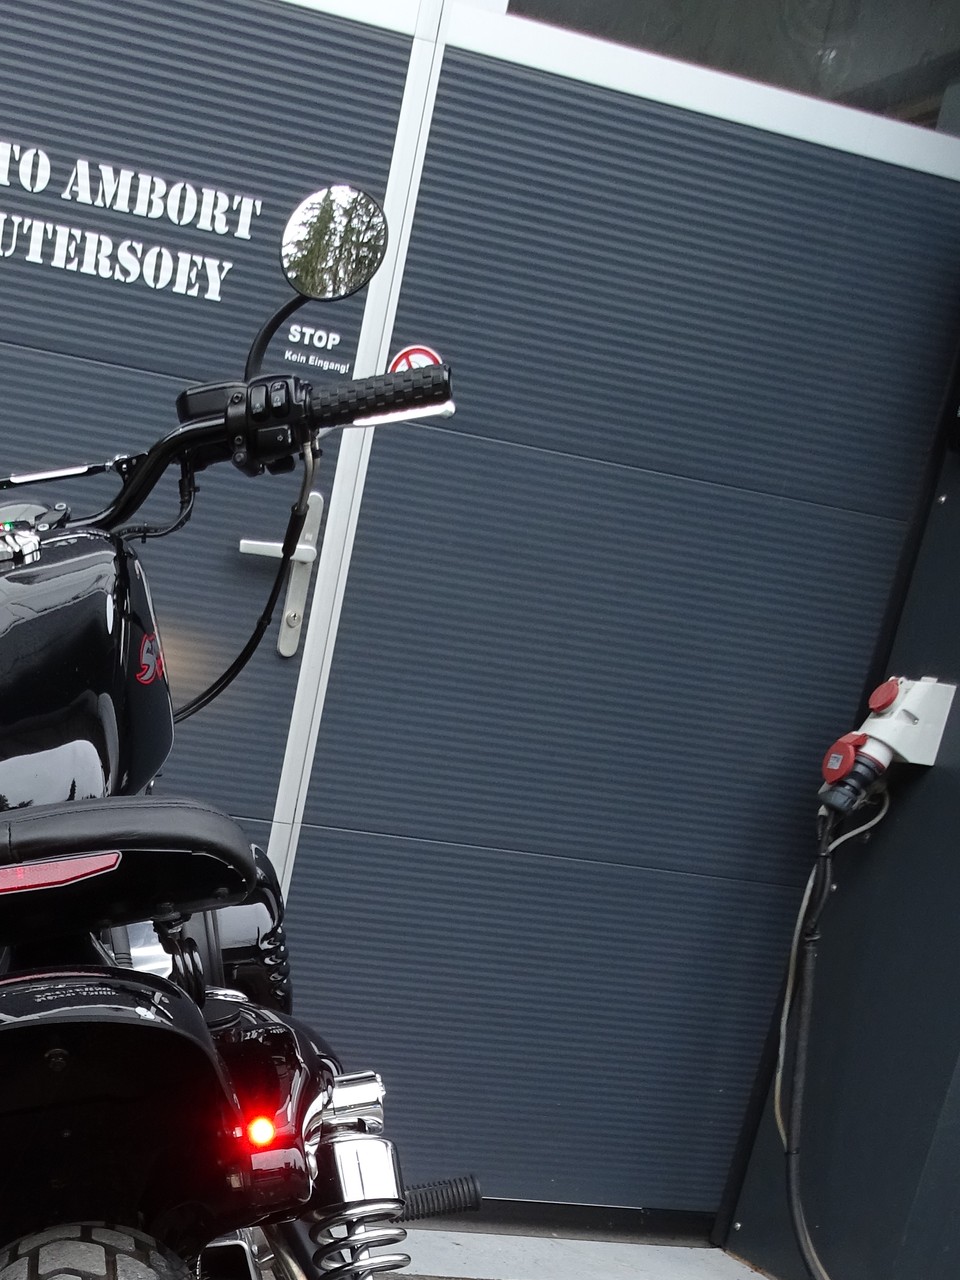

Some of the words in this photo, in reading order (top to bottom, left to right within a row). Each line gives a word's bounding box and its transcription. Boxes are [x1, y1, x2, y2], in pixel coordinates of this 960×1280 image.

[61, 159, 263, 241] AMBORT
[288, 324, 341, 350] STOP
[284, 350, 307, 364] Kein
[309, 356, 350, 375] Eingang!
